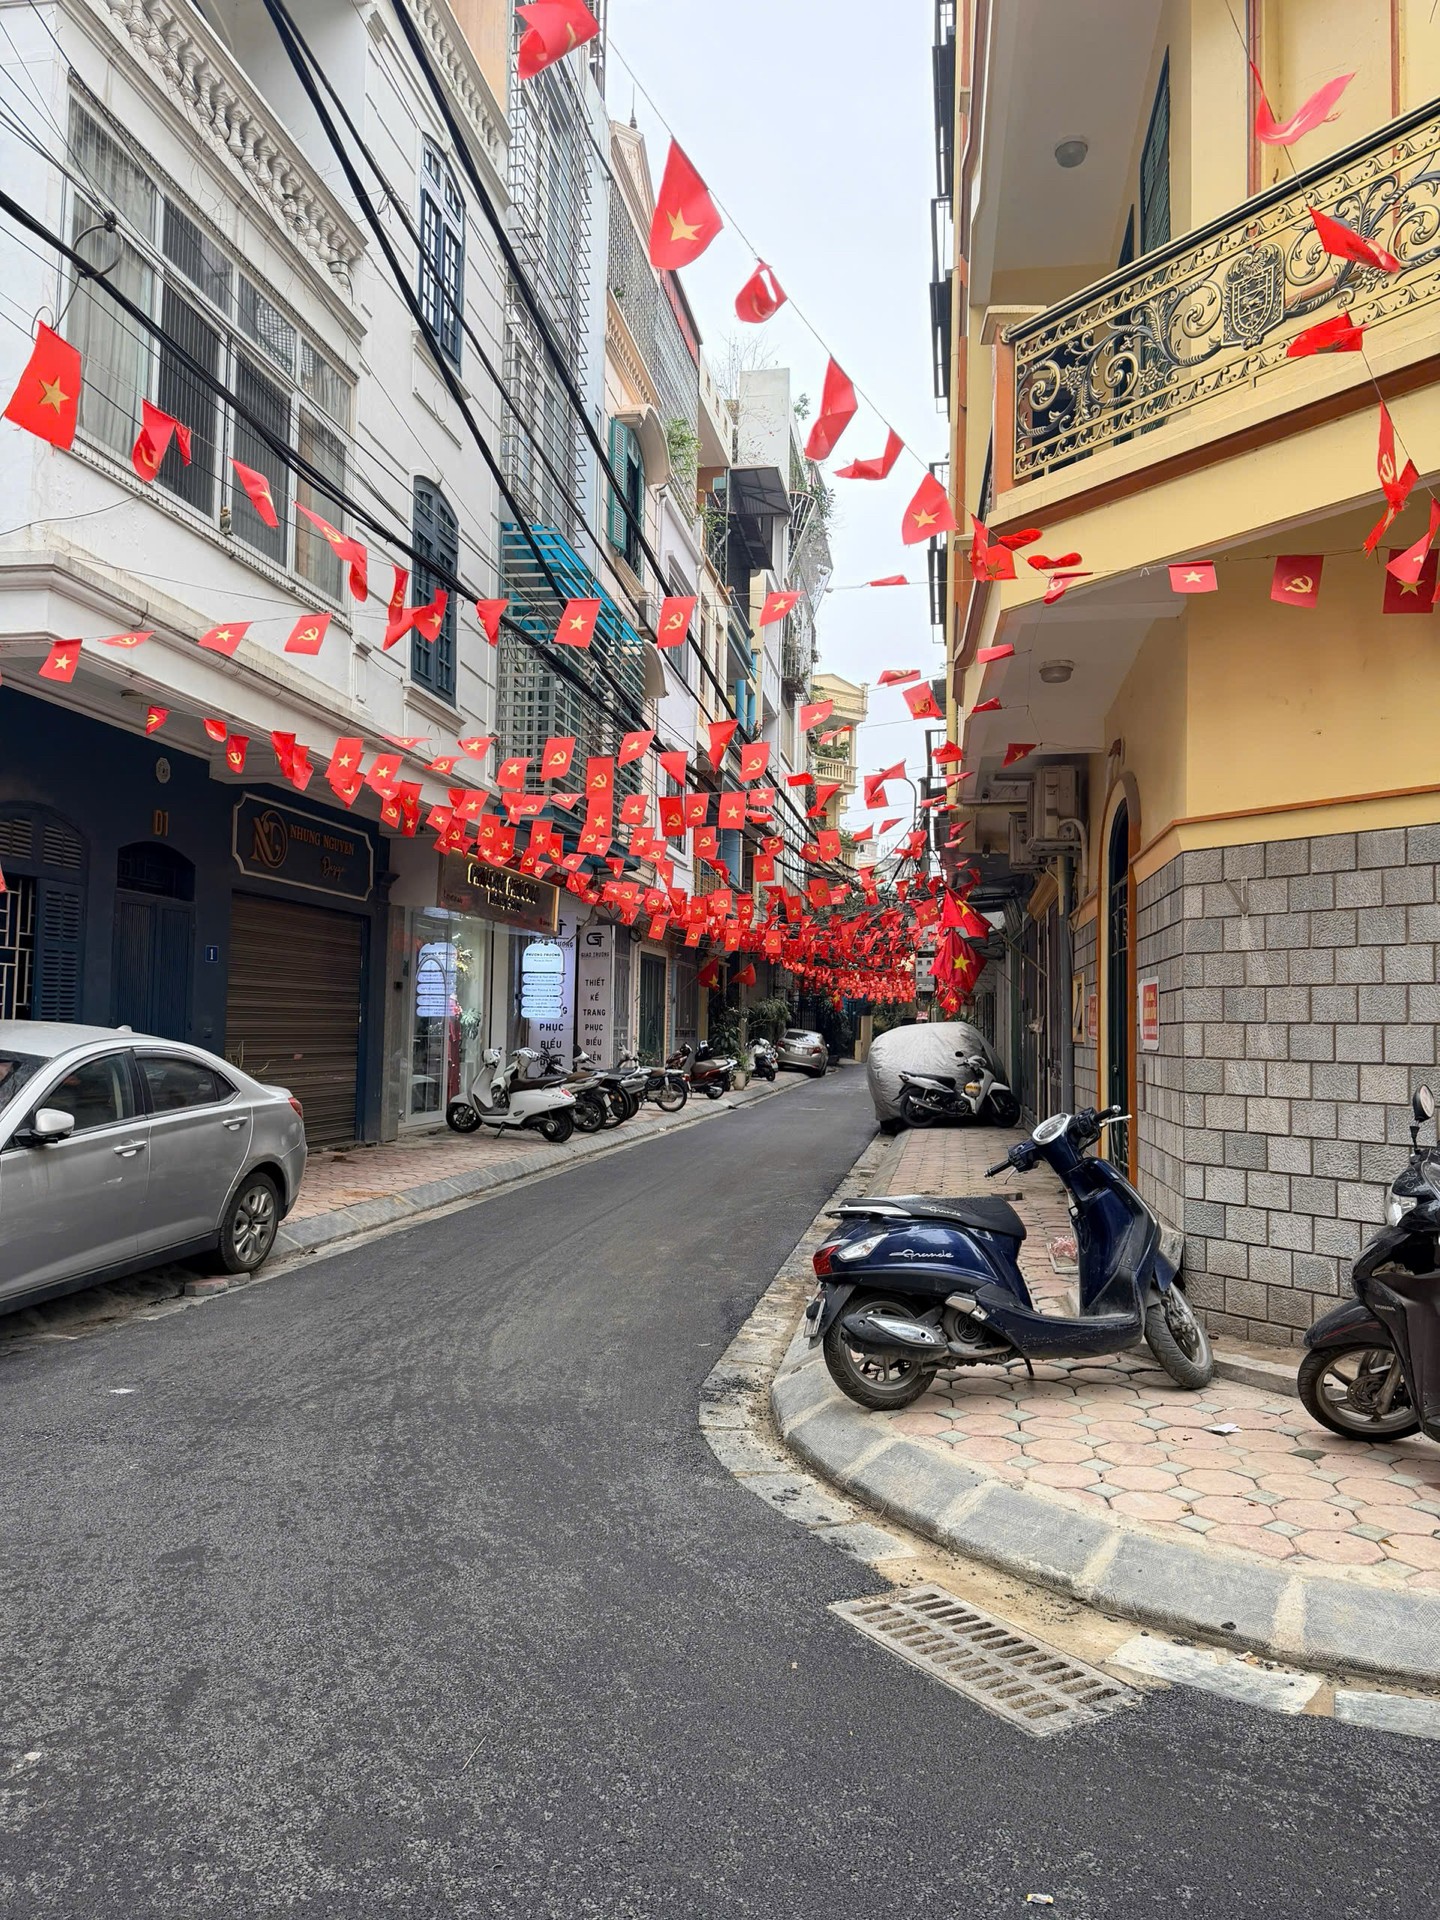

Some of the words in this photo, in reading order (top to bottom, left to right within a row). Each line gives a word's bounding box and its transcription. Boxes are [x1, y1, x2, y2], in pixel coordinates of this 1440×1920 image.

[289, 823, 321, 847] NHUNG
[583, 1008, 606, 1016] TRANG
[539, 1023, 564, 1033] PHỤC
[584, 1023, 604, 1032] PHỤC
[920, 1205, 962, 1217] Grande
[889, 1248, 955, 1260] Grande
